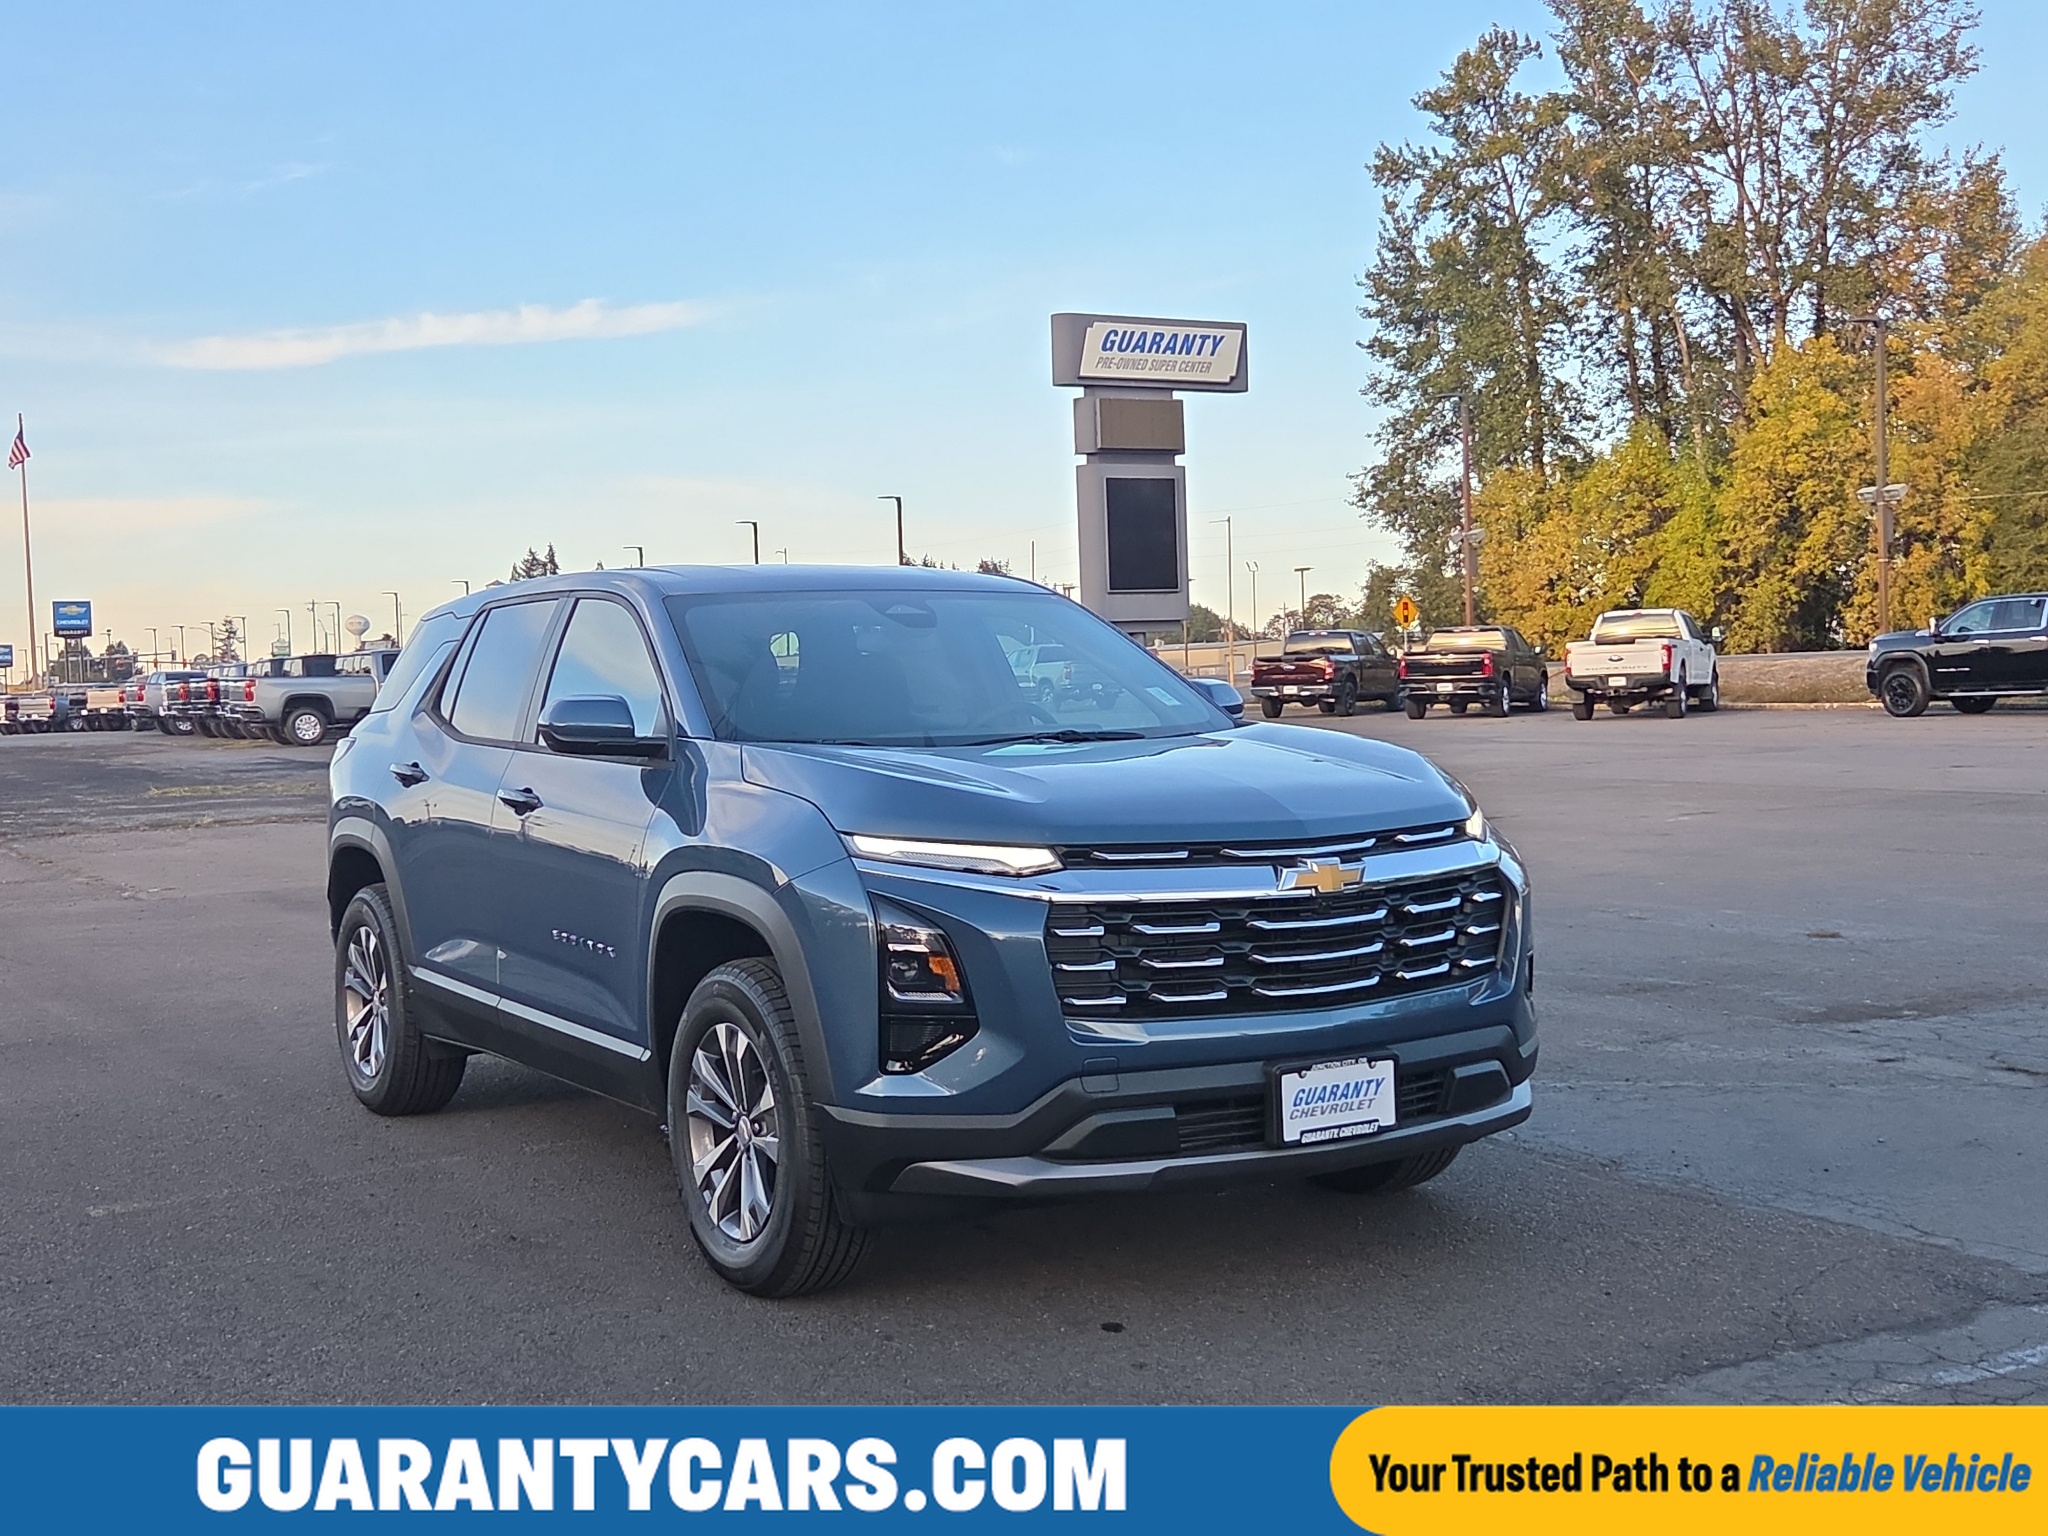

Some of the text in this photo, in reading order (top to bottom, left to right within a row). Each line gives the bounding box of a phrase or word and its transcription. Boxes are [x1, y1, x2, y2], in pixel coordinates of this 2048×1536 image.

[1101, 329, 1226, 357] GUARANTY
[1095, 356, 1213, 374] PRE-OWNED SUPER CENTER
[1292, 1077, 1385, 1107] GUARANTY
[1289, 1098, 1376, 1121] CHEVROLET
[1301, 1122, 1379, 1143] GUARANTY CHEVROLET
